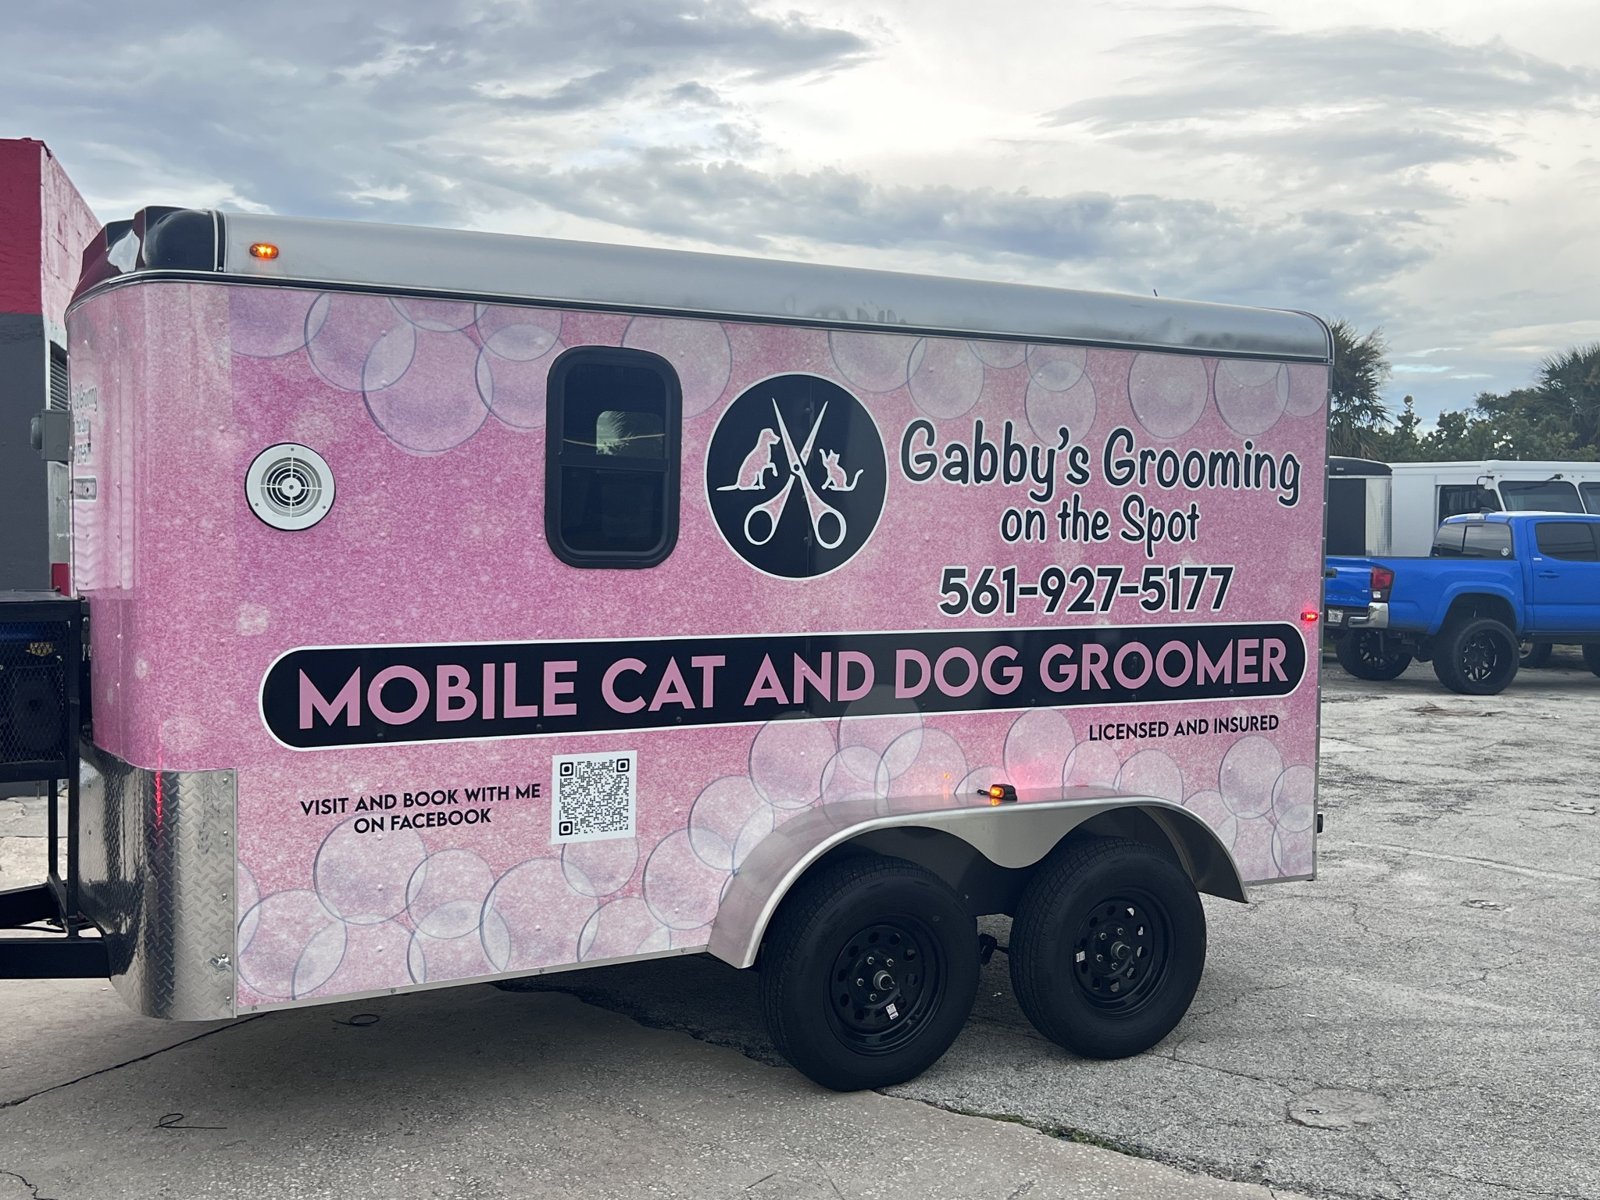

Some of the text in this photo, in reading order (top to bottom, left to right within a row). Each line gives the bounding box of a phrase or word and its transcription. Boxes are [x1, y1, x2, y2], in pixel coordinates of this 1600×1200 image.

[901, 418, 1302, 508] Gabby's Grooming
[1000, 493, 1201, 558] on the Spot
[938, 564, 1235, 617] 561-927-5177
[298, 638, 1289, 730] MOBILE CAT AND DOG GROOMER
[1089, 715, 1279, 741] LICENSED AND INSURED
[300, 783, 541, 816] VISIT AND BOOK WITH ME
[353, 808, 492, 835] ON FACEBOOK
